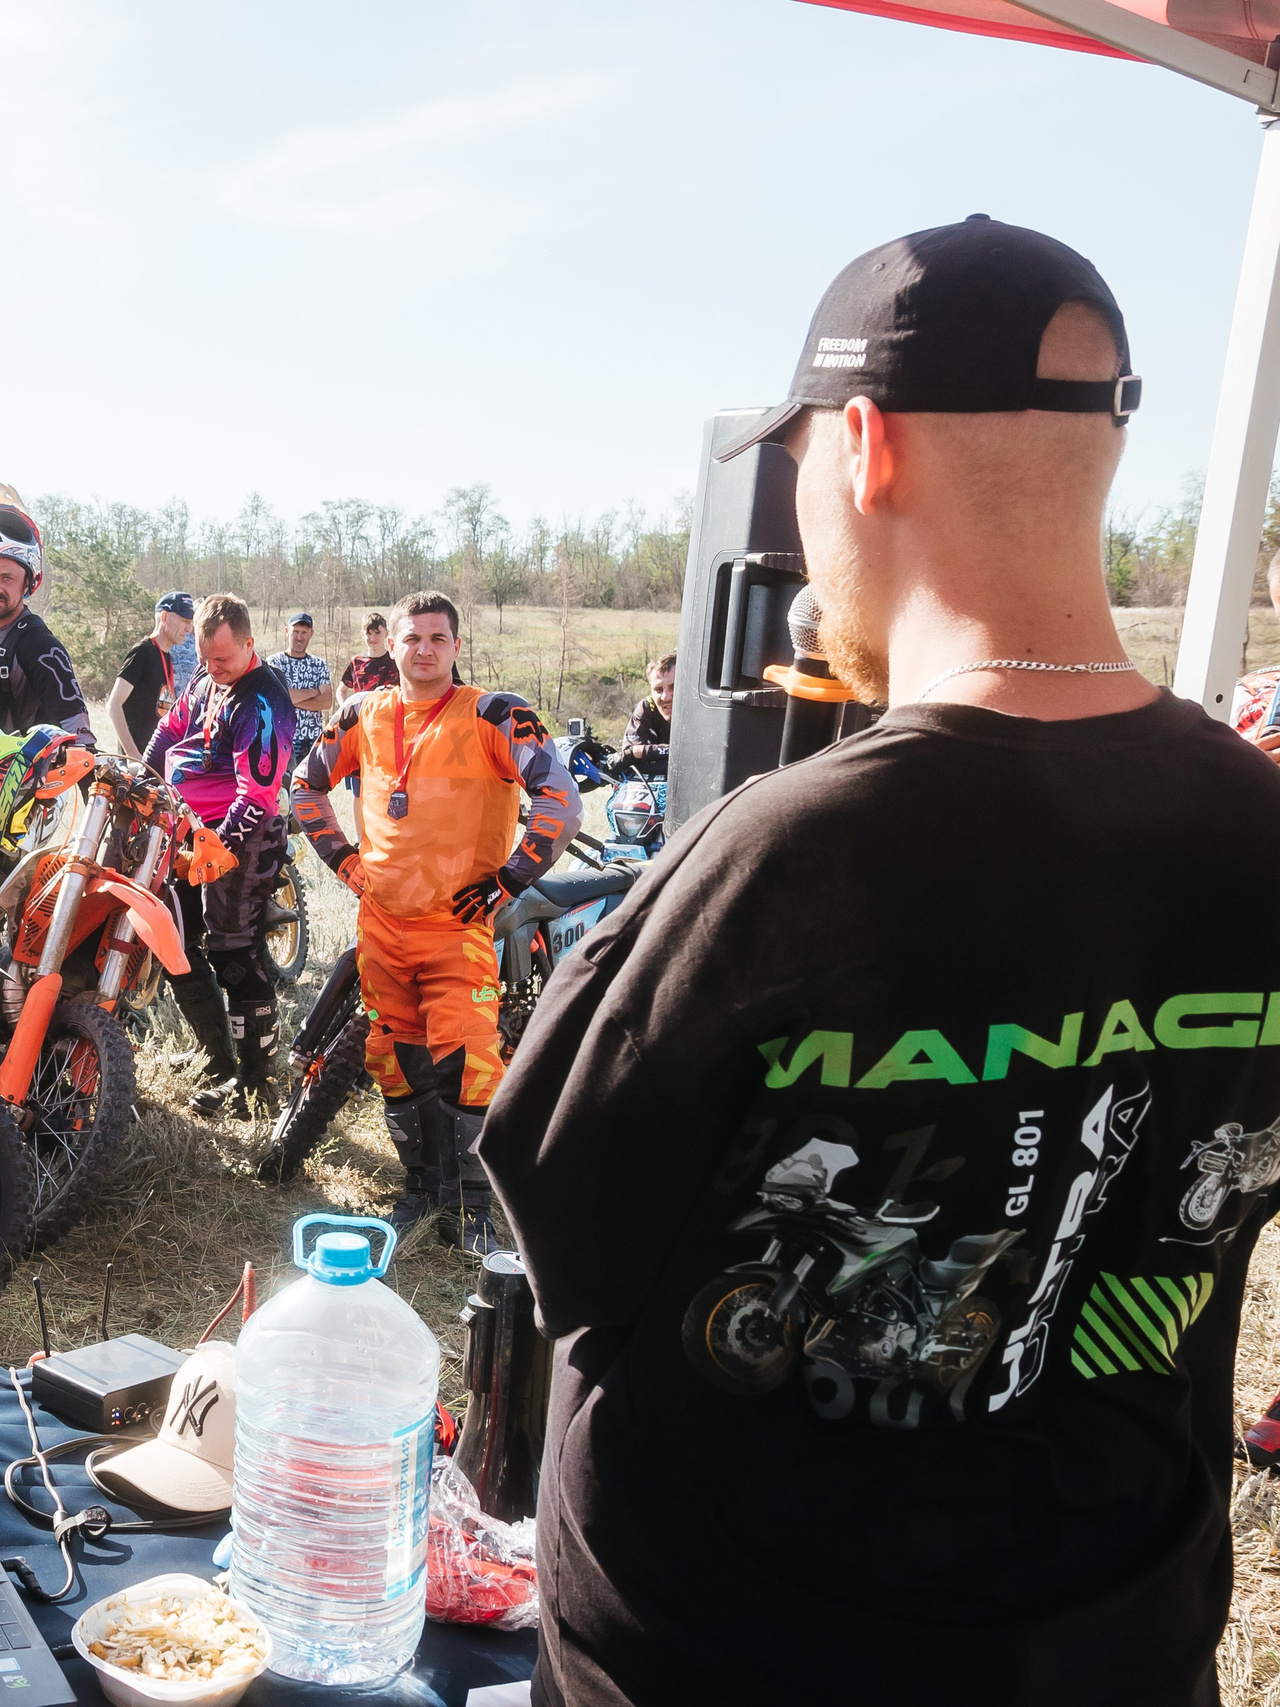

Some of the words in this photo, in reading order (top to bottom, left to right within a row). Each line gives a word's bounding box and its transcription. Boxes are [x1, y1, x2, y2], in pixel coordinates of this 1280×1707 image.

[818, 337, 868, 352] FREEDOM
[822, 353, 866, 368] MOTION
[521, 786, 570, 864] FOX
[486, 888, 502, 905] KTM
[552, 921, 585, 956] 300
[757, 992, 1280, 1089] MANAG
[1011, 1109, 1045, 1171] 801
[1005, 1174, 1034, 1217] GL
[988, 1083, 1114, 1413] ULTRA
